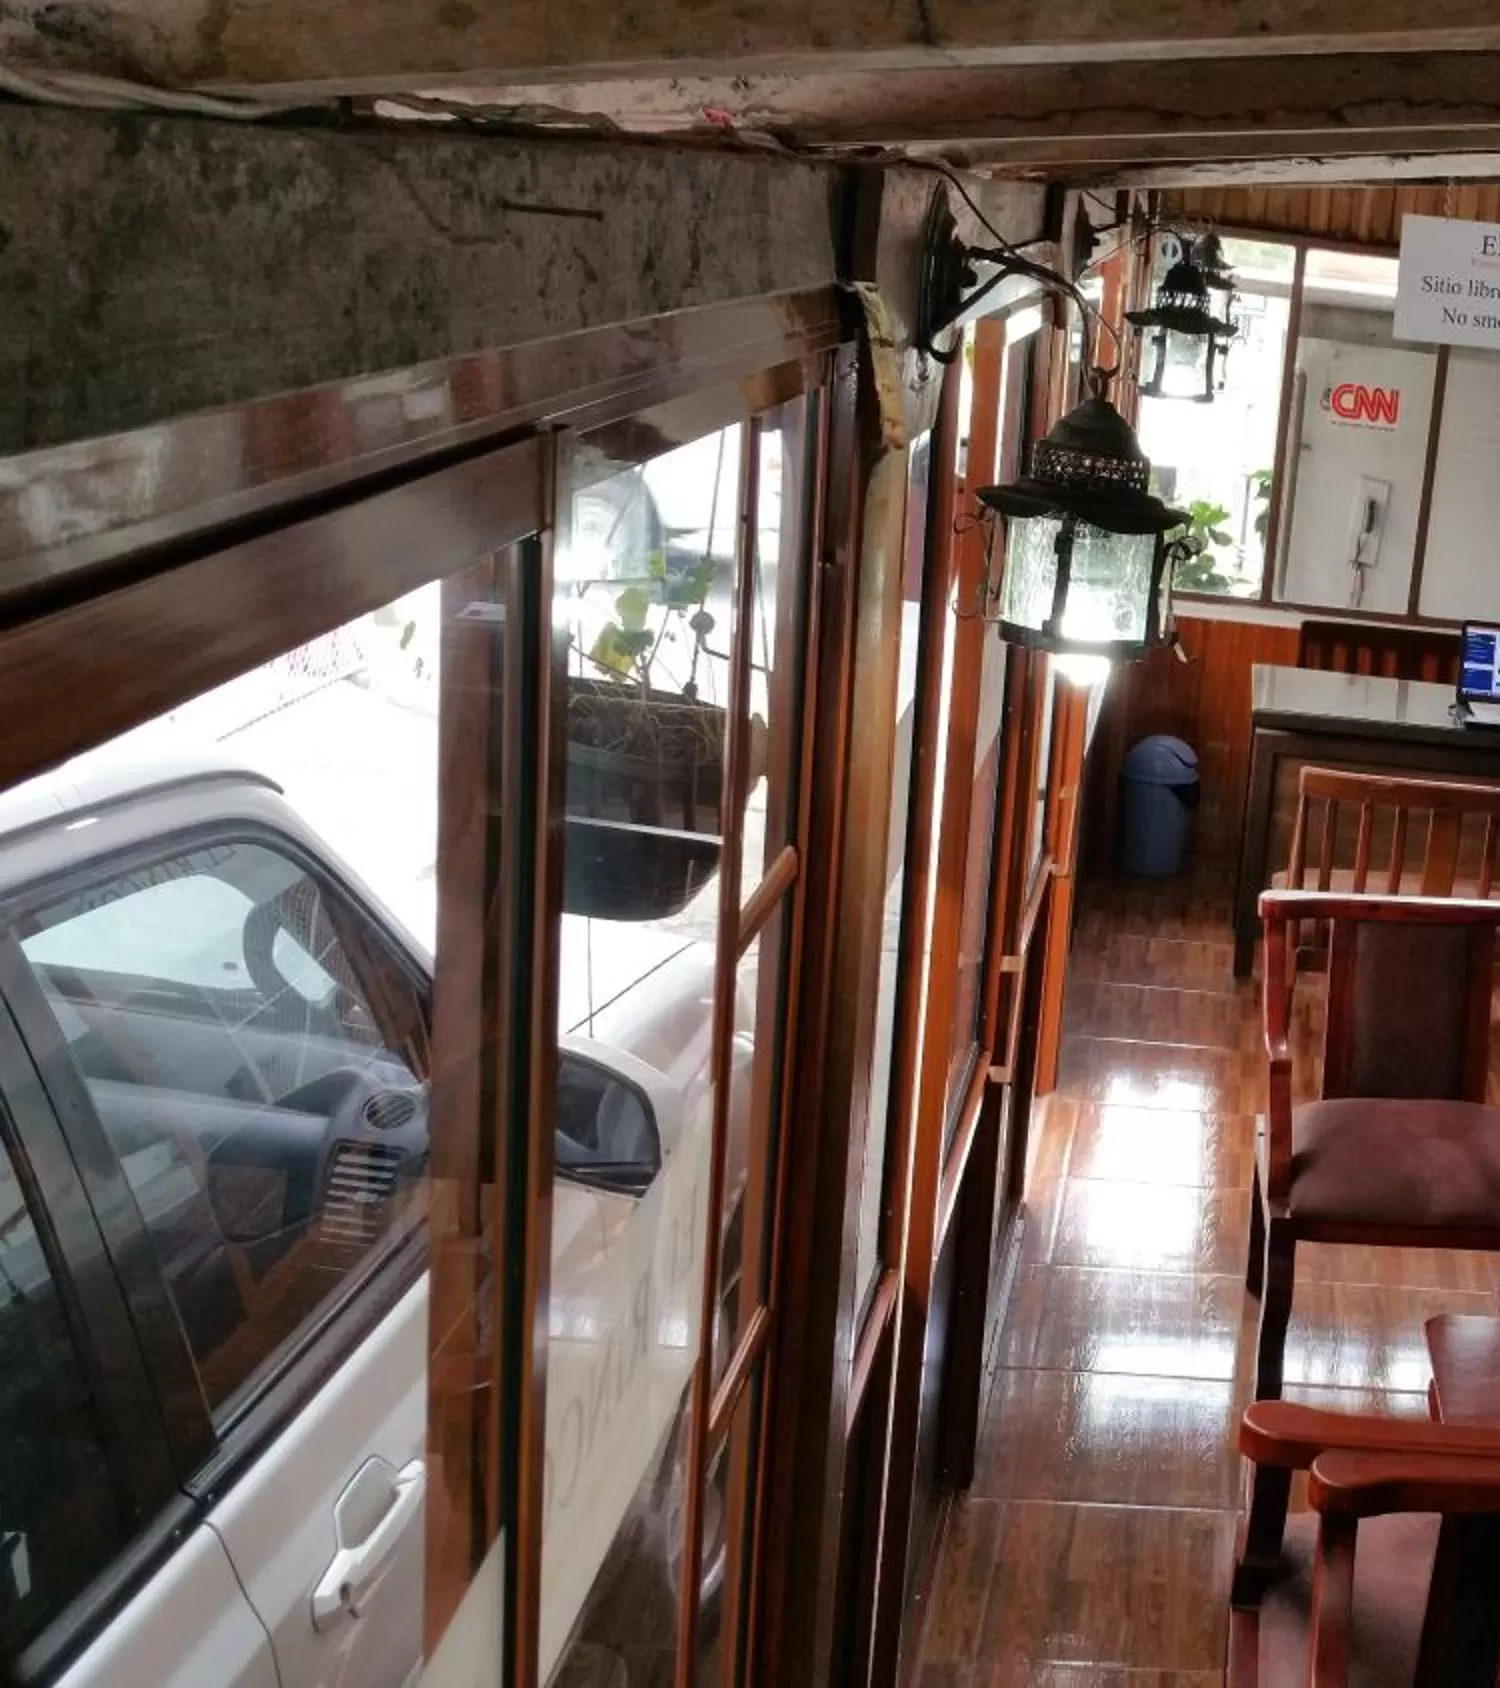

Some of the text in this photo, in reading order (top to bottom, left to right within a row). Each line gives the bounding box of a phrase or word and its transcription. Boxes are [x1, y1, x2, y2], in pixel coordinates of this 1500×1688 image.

[1421, 275, 1462, 295] Sitio
[1442, 307, 1468, 326] No
[1331, 383, 1400, 425] CNN
